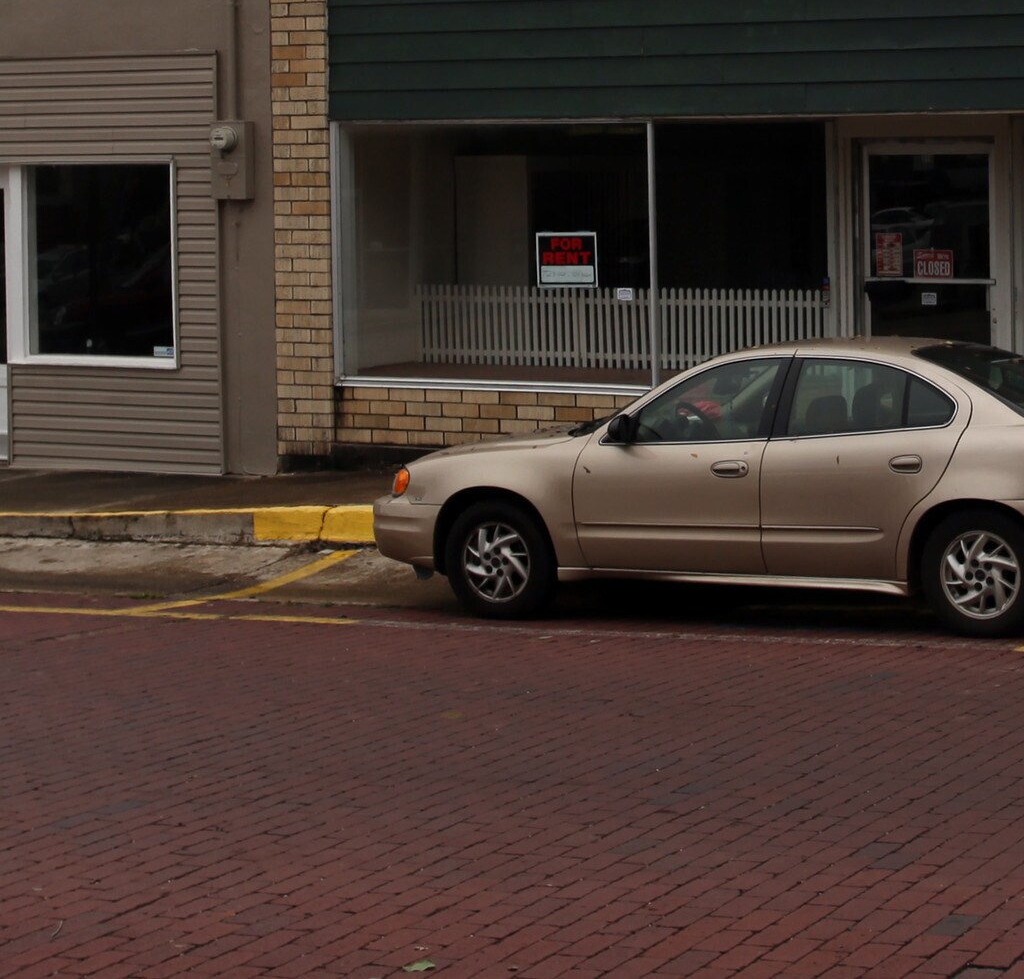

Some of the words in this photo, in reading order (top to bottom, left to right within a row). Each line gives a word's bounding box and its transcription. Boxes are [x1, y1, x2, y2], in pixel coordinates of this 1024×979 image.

[550, 238, 583, 250] FOR
[542, 251, 591, 265] RENT
[917, 261, 951, 276] CLOSED
